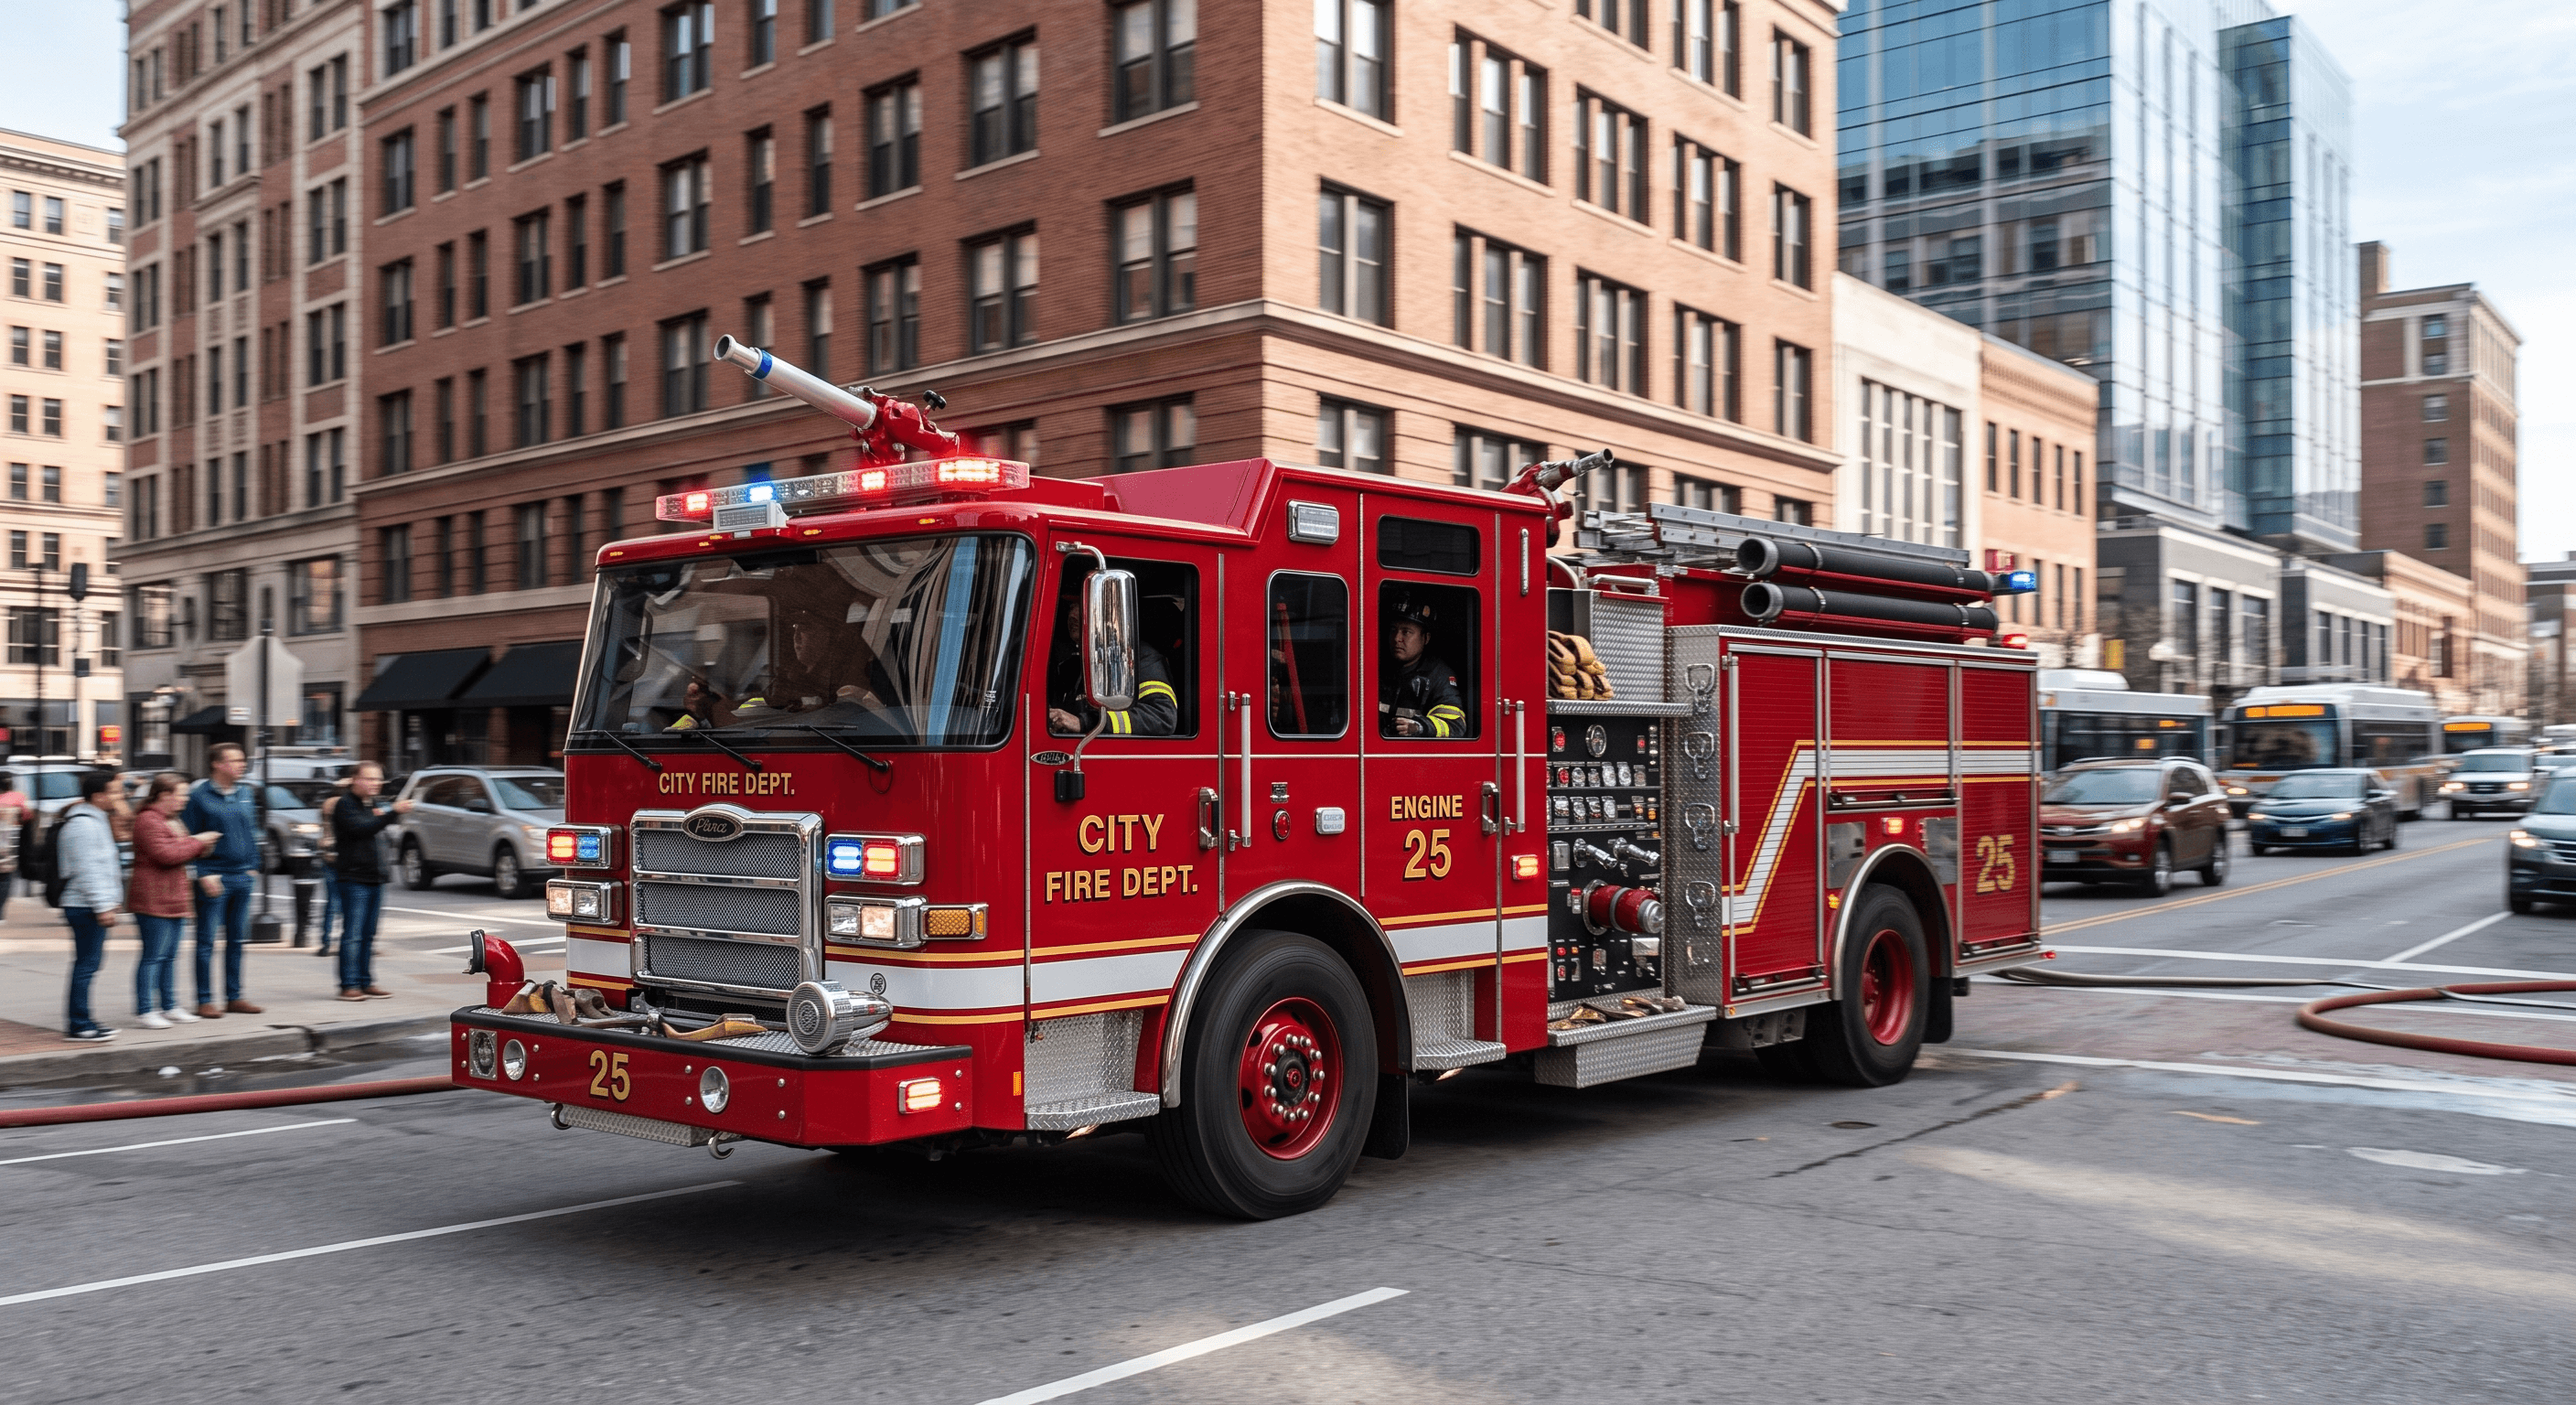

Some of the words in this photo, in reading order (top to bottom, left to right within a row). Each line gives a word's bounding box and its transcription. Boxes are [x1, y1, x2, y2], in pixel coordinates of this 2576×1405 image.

[659, 772, 696, 794] CITY
[702, 772, 739, 795] FIRE
[745, 772, 795, 795] DEPT.
[1390, 794, 1464, 820] ENGINE
[1079, 813, 1165, 853] CITY
[1403, 828, 1452, 879] 25
[1976, 833, 2016, 894] 25
[1046, 868, 1111, 902] FIRE
[1122, 864, 1198, 896] DEPT.
[589, 1049, 631, 1101] 25
